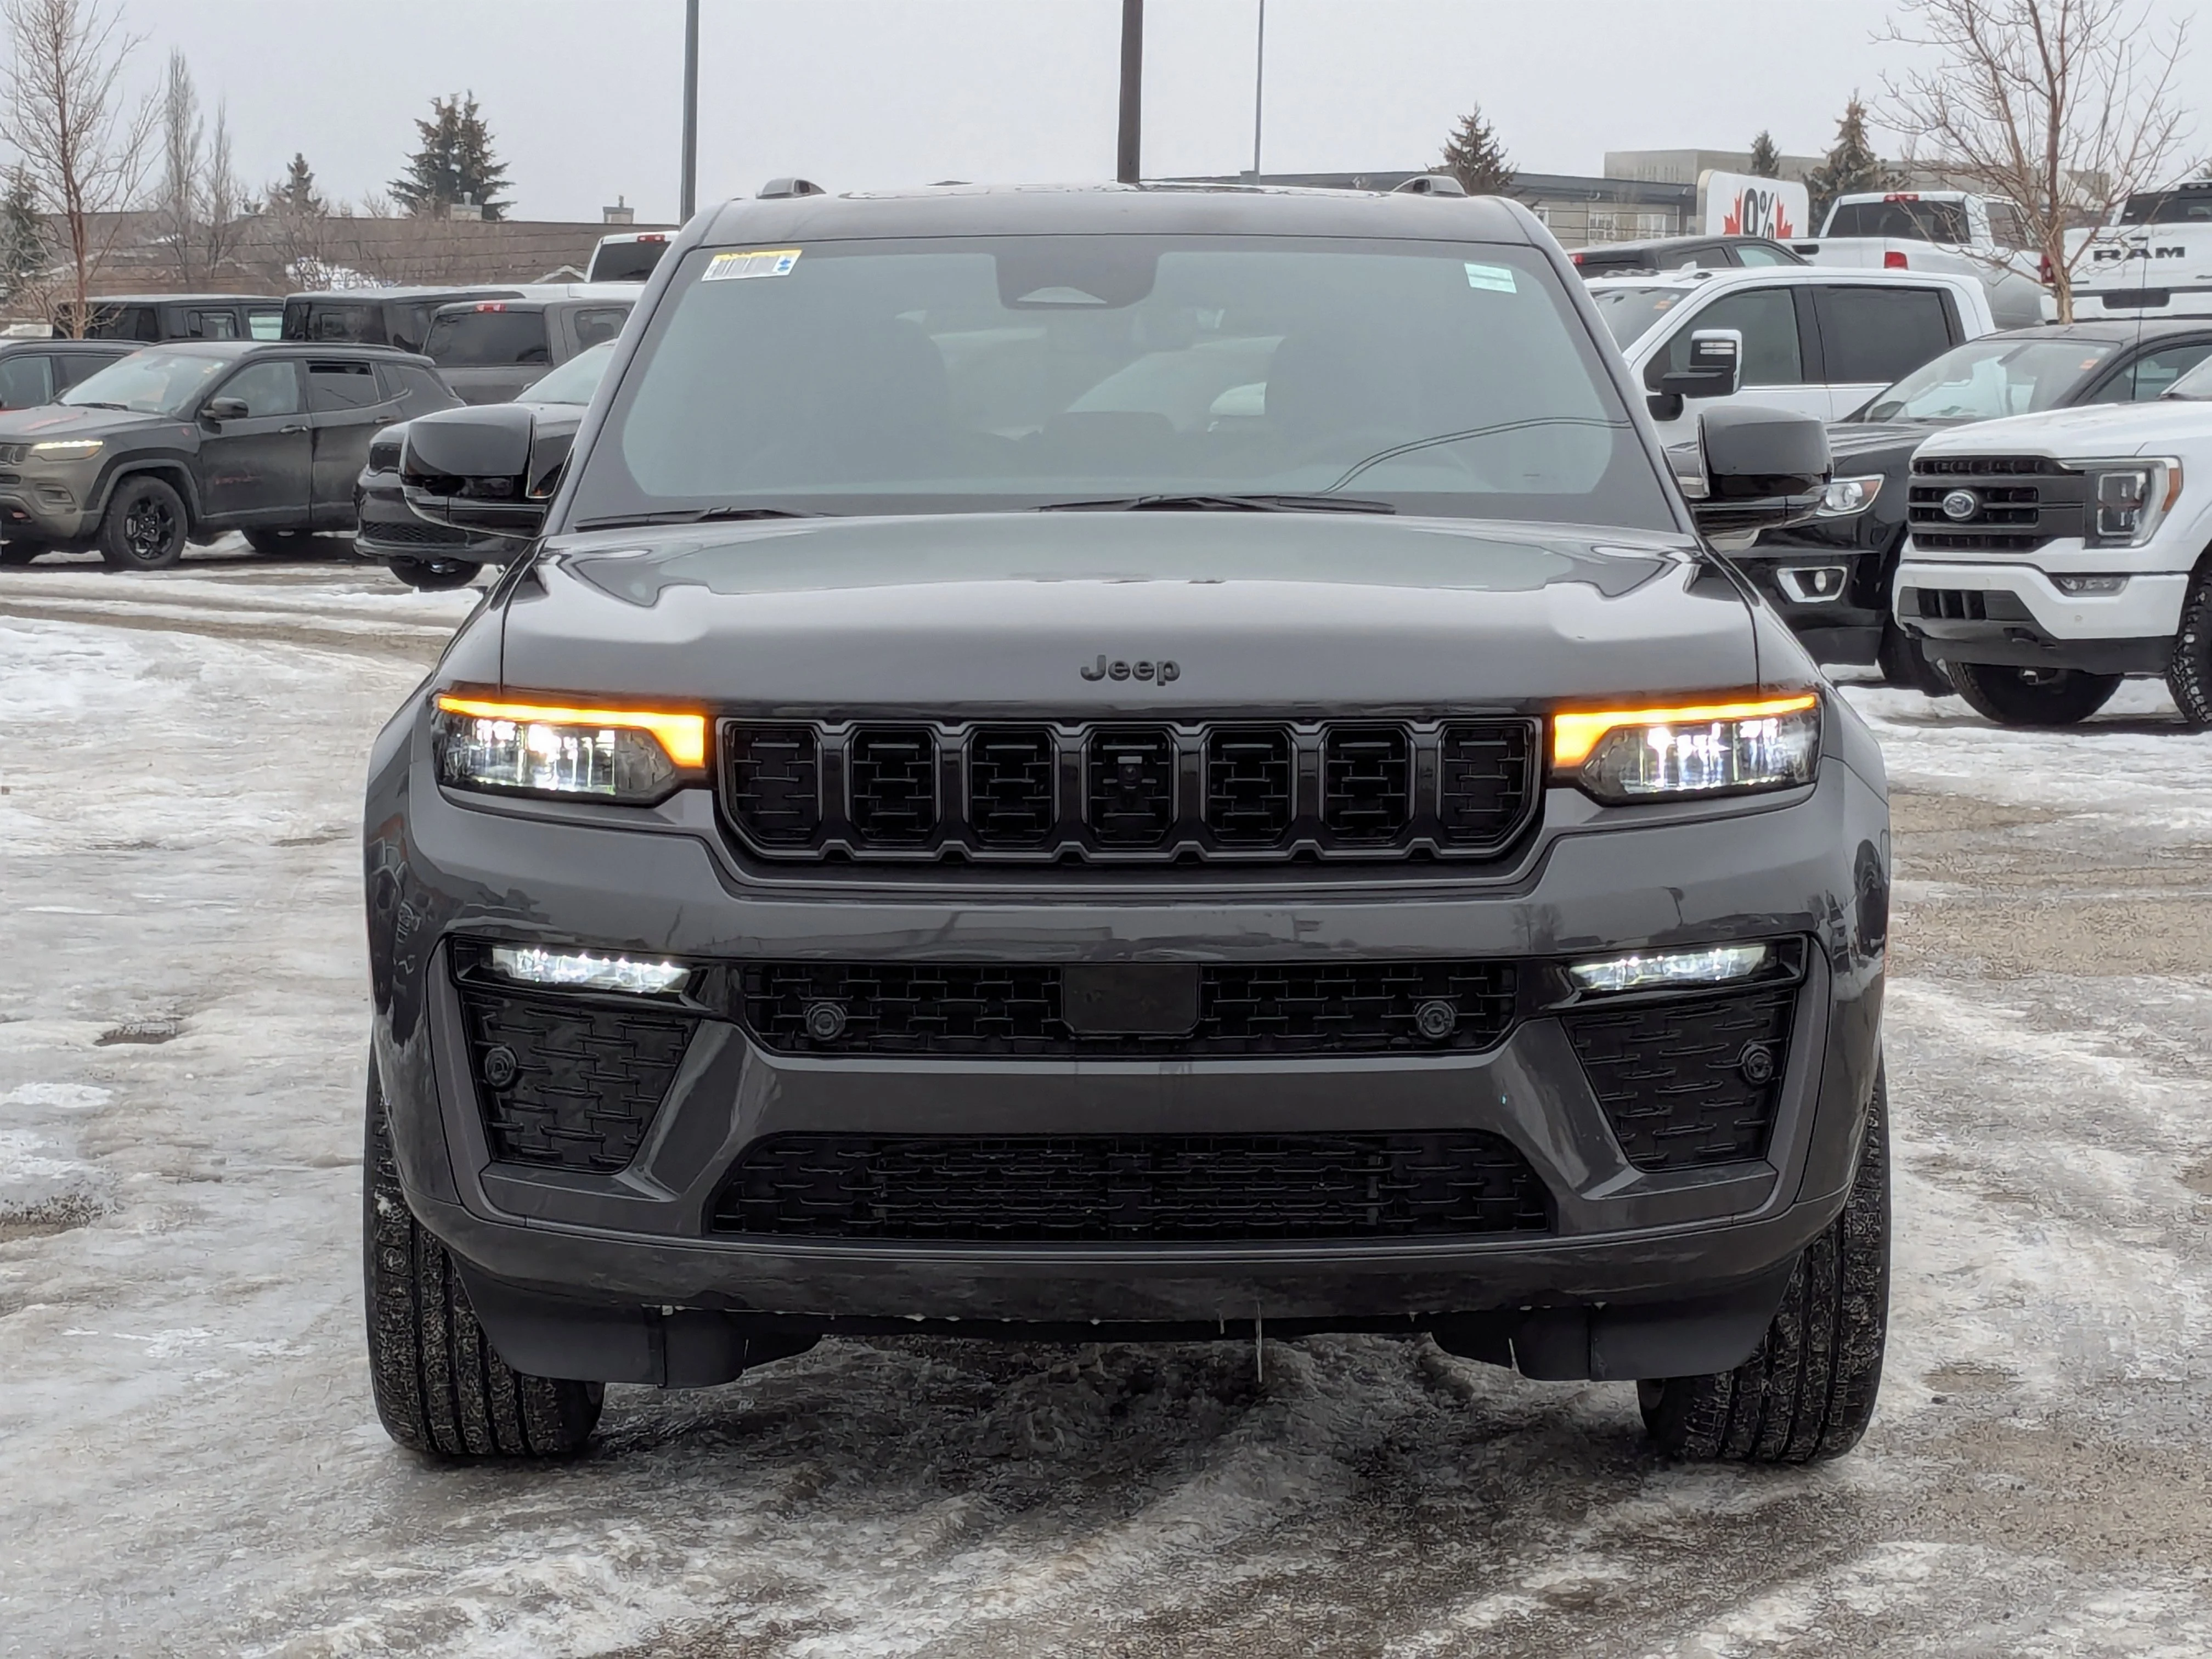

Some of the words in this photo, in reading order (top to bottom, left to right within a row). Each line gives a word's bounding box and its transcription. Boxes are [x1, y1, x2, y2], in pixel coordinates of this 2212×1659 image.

[1743, 188, 1774, 240] 0%
[2094, 247, 2185, 261] RAM
[1080, 654, 1180, 686] Jeep
